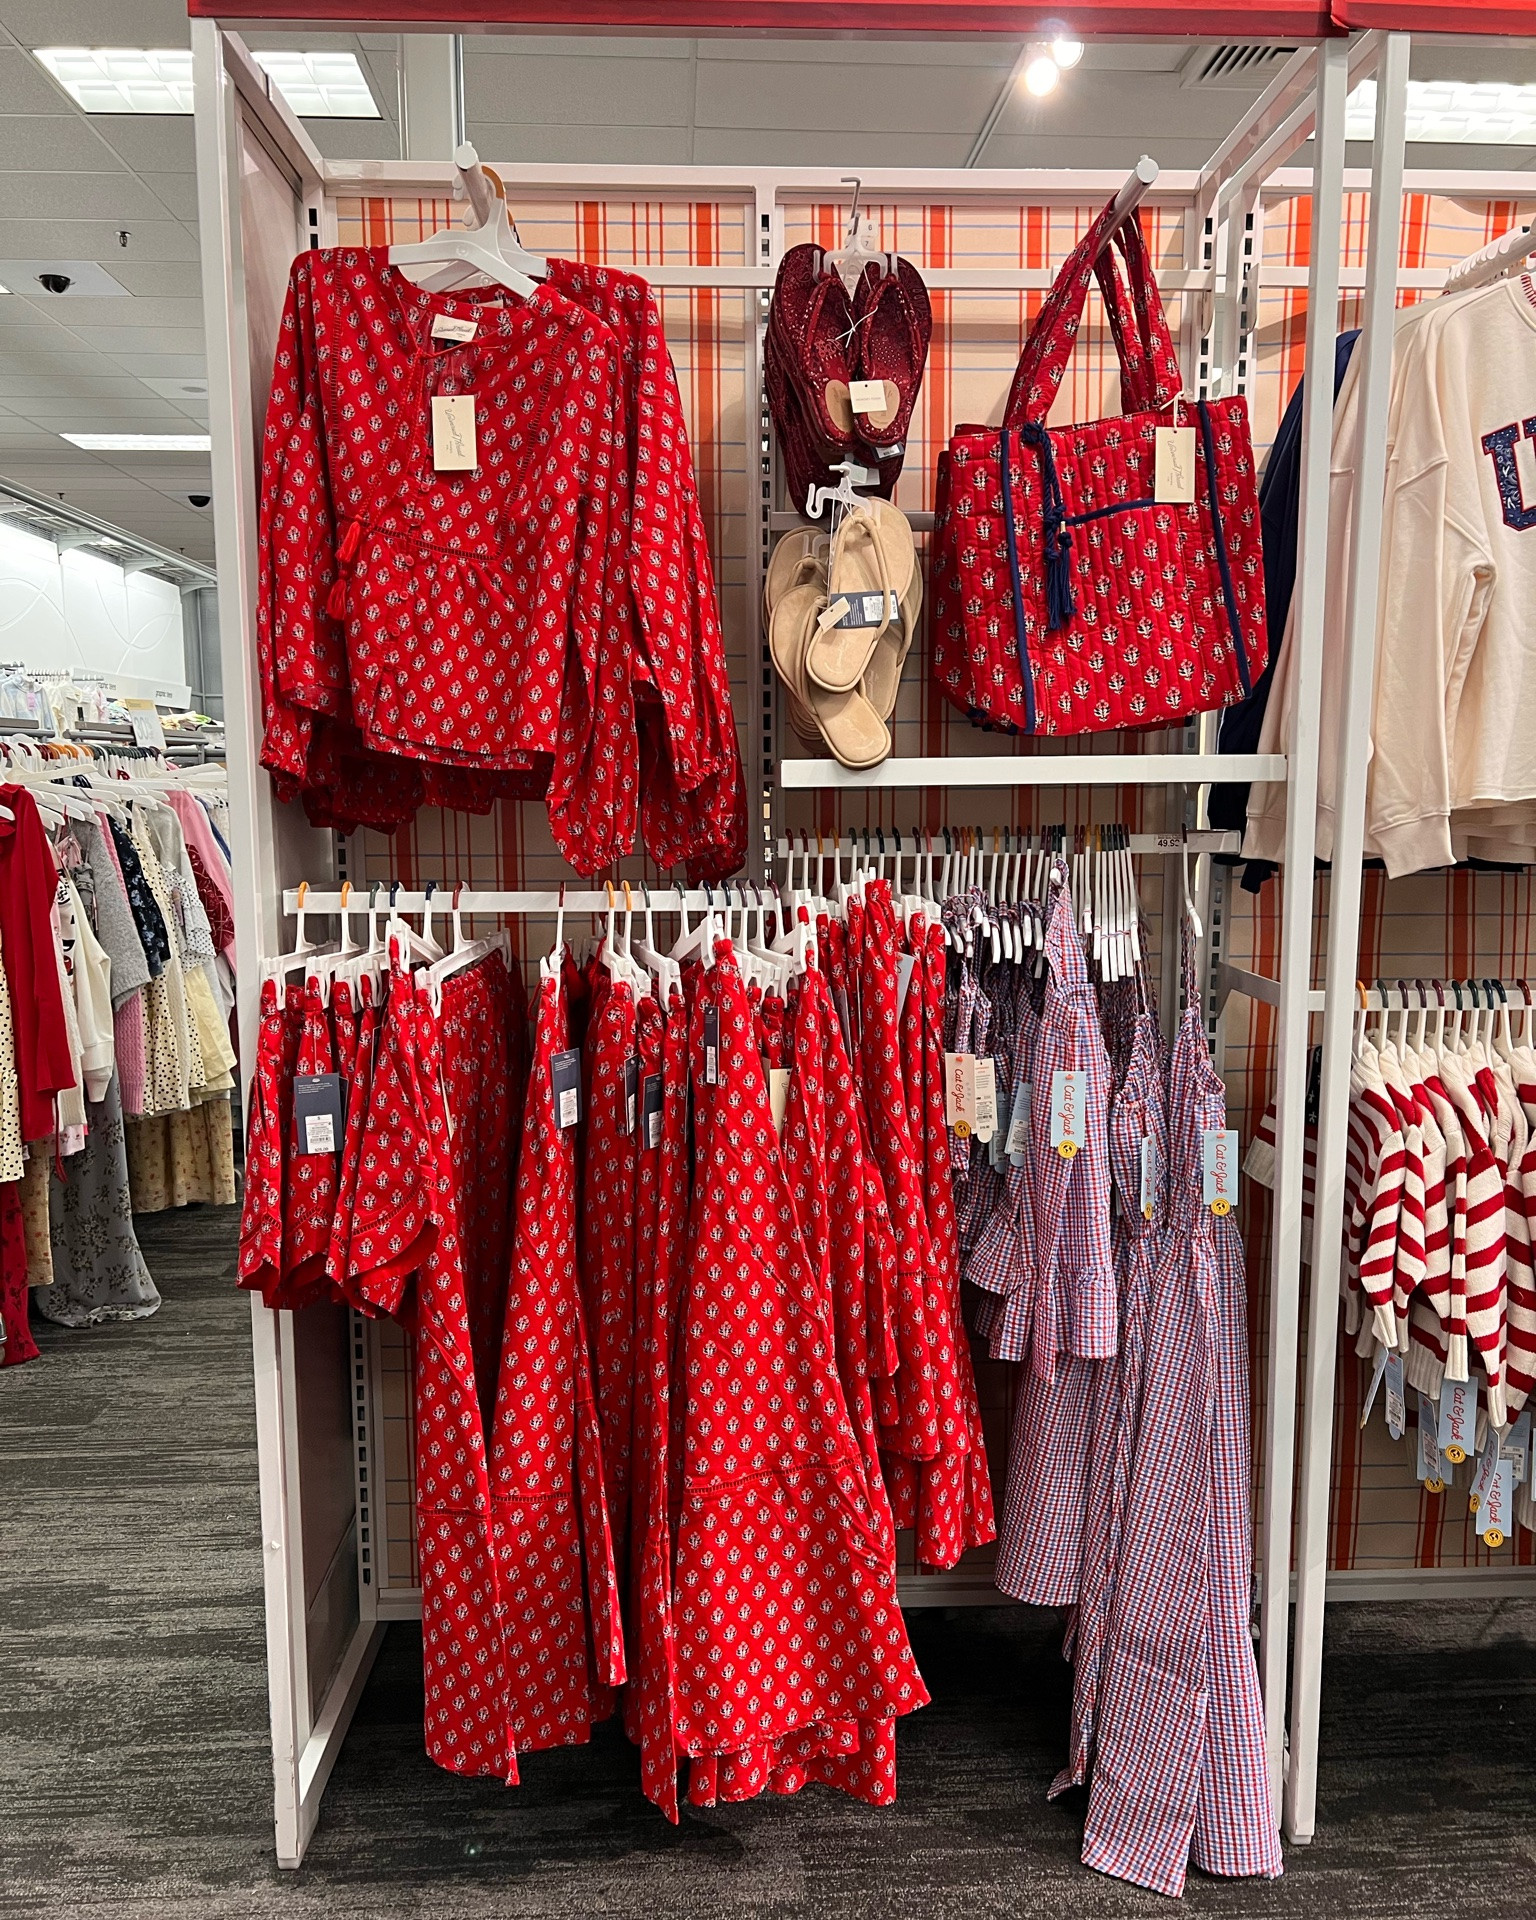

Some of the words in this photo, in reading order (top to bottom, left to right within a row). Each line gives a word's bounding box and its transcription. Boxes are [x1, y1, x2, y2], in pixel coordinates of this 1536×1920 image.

[955, 1068, 964, 1084] Cat
[955, 1083, 964, 1093] &
[1064, 1085, 1075, 1101] Cat
[951, 1091, 965, 1113] Jack
[1064, 1102, 1074, 1113] &
[1058, 1111, 1075, 1137] Jack
[1216, 1144, 1227, 1161] Cat
[1216, 1162, 1227, 1171] &
[1210, 1170, 1228, 1194] Jack
[1454, 1387, 1466, 1405] Cat
[1453, 1405, 1464, 1417] &
[1446, 1413, 1464, 1440] Jack
[1478, 1464, 1490, 1491] Jack
[1490, 1490, 1501, 1501] &
[1486, 1500, 1502, 1524] Jack
